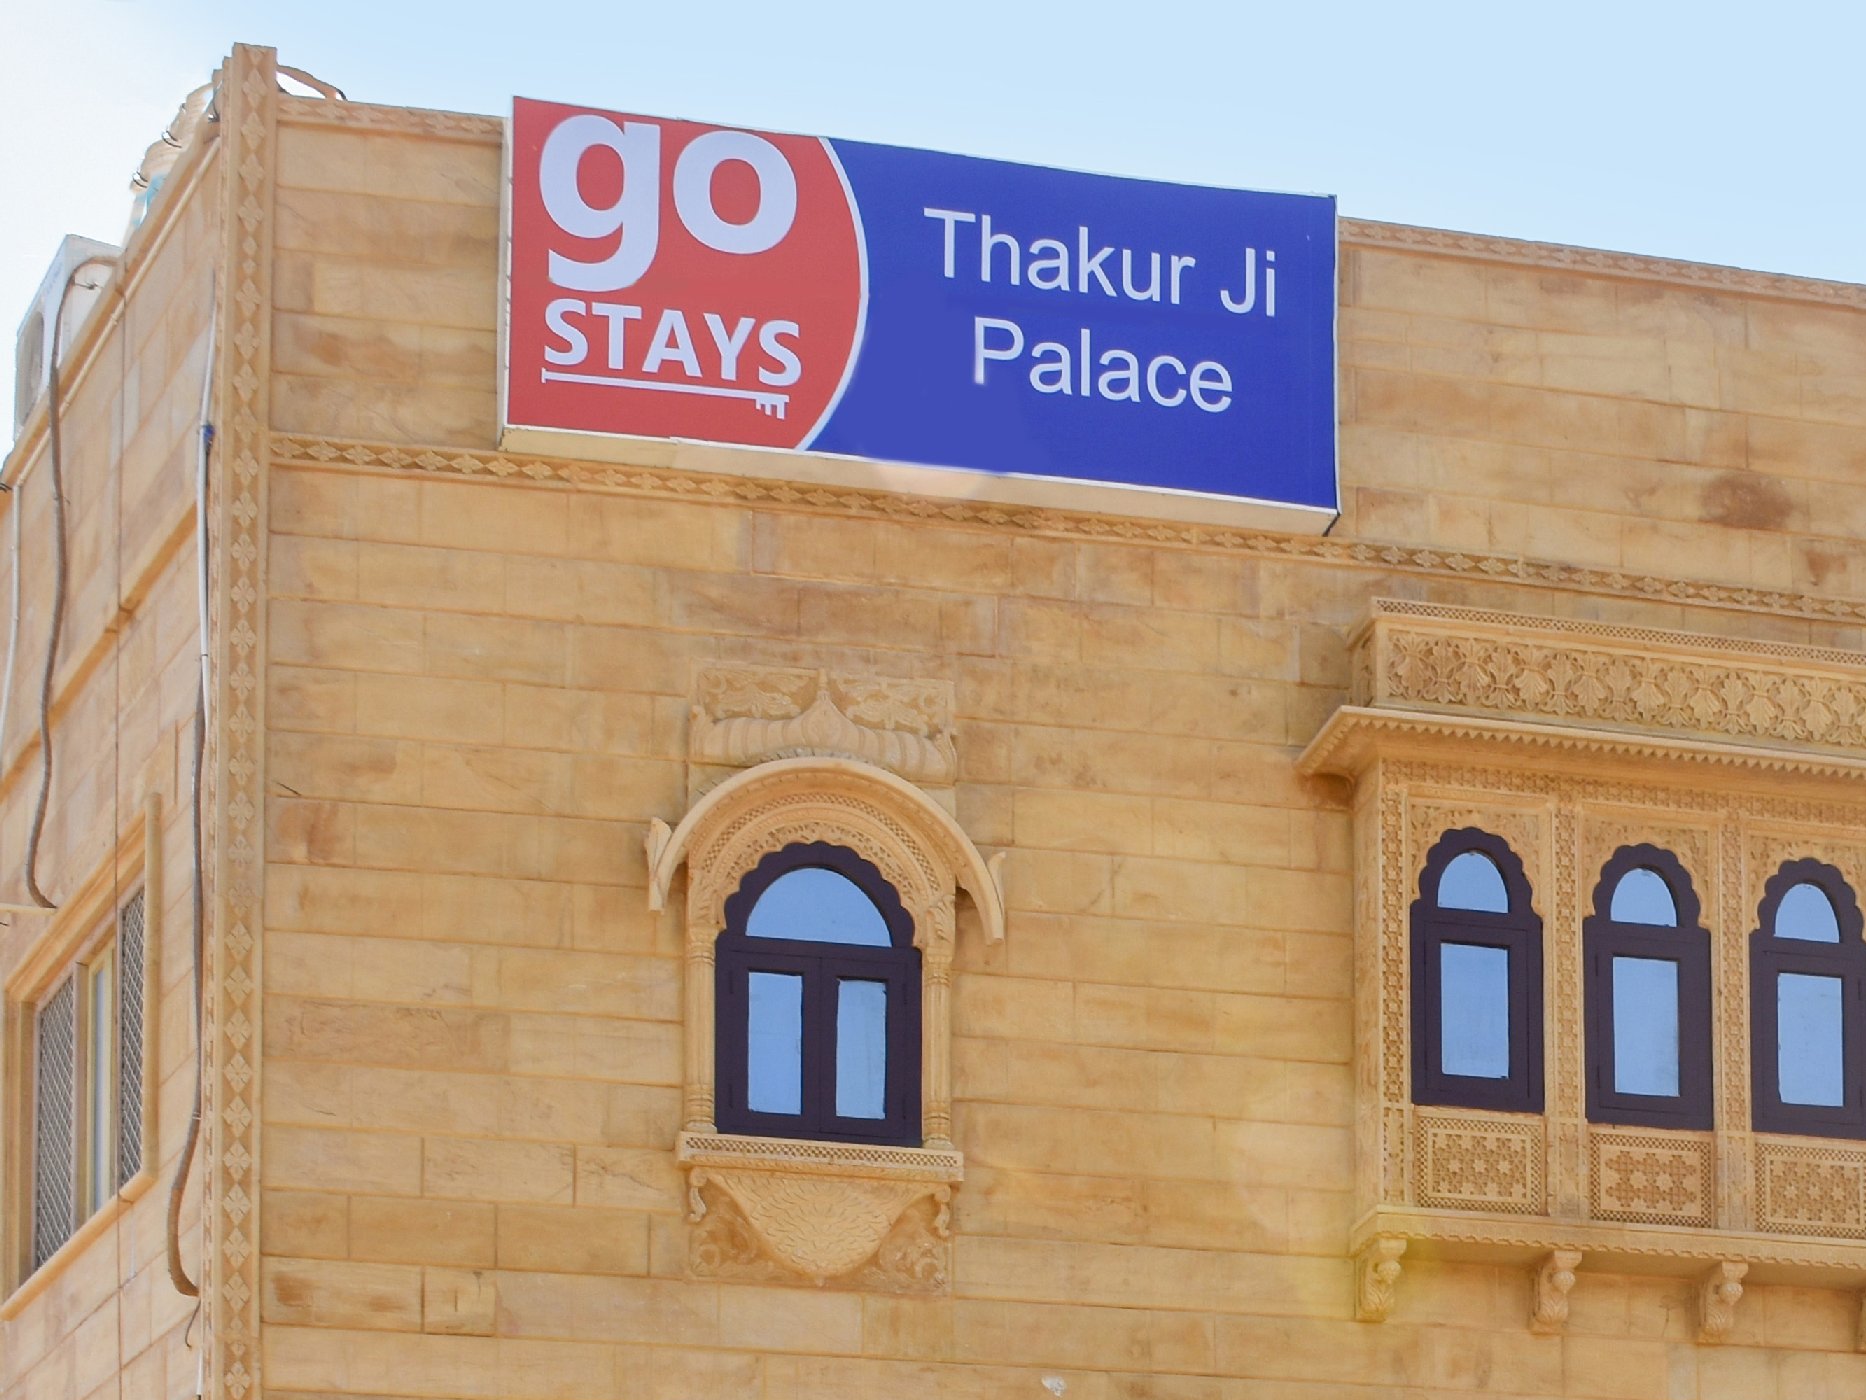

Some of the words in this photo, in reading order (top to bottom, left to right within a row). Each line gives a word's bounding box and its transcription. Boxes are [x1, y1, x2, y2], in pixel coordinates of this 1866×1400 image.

[537, 113, 798, 293] go
[923, 206, 1196, 306] Thakur
[1220, 247, 1277, 317] Ji
[542, 298, 803, 387] STAYS
[973, 316, 1234, 413] Palace
